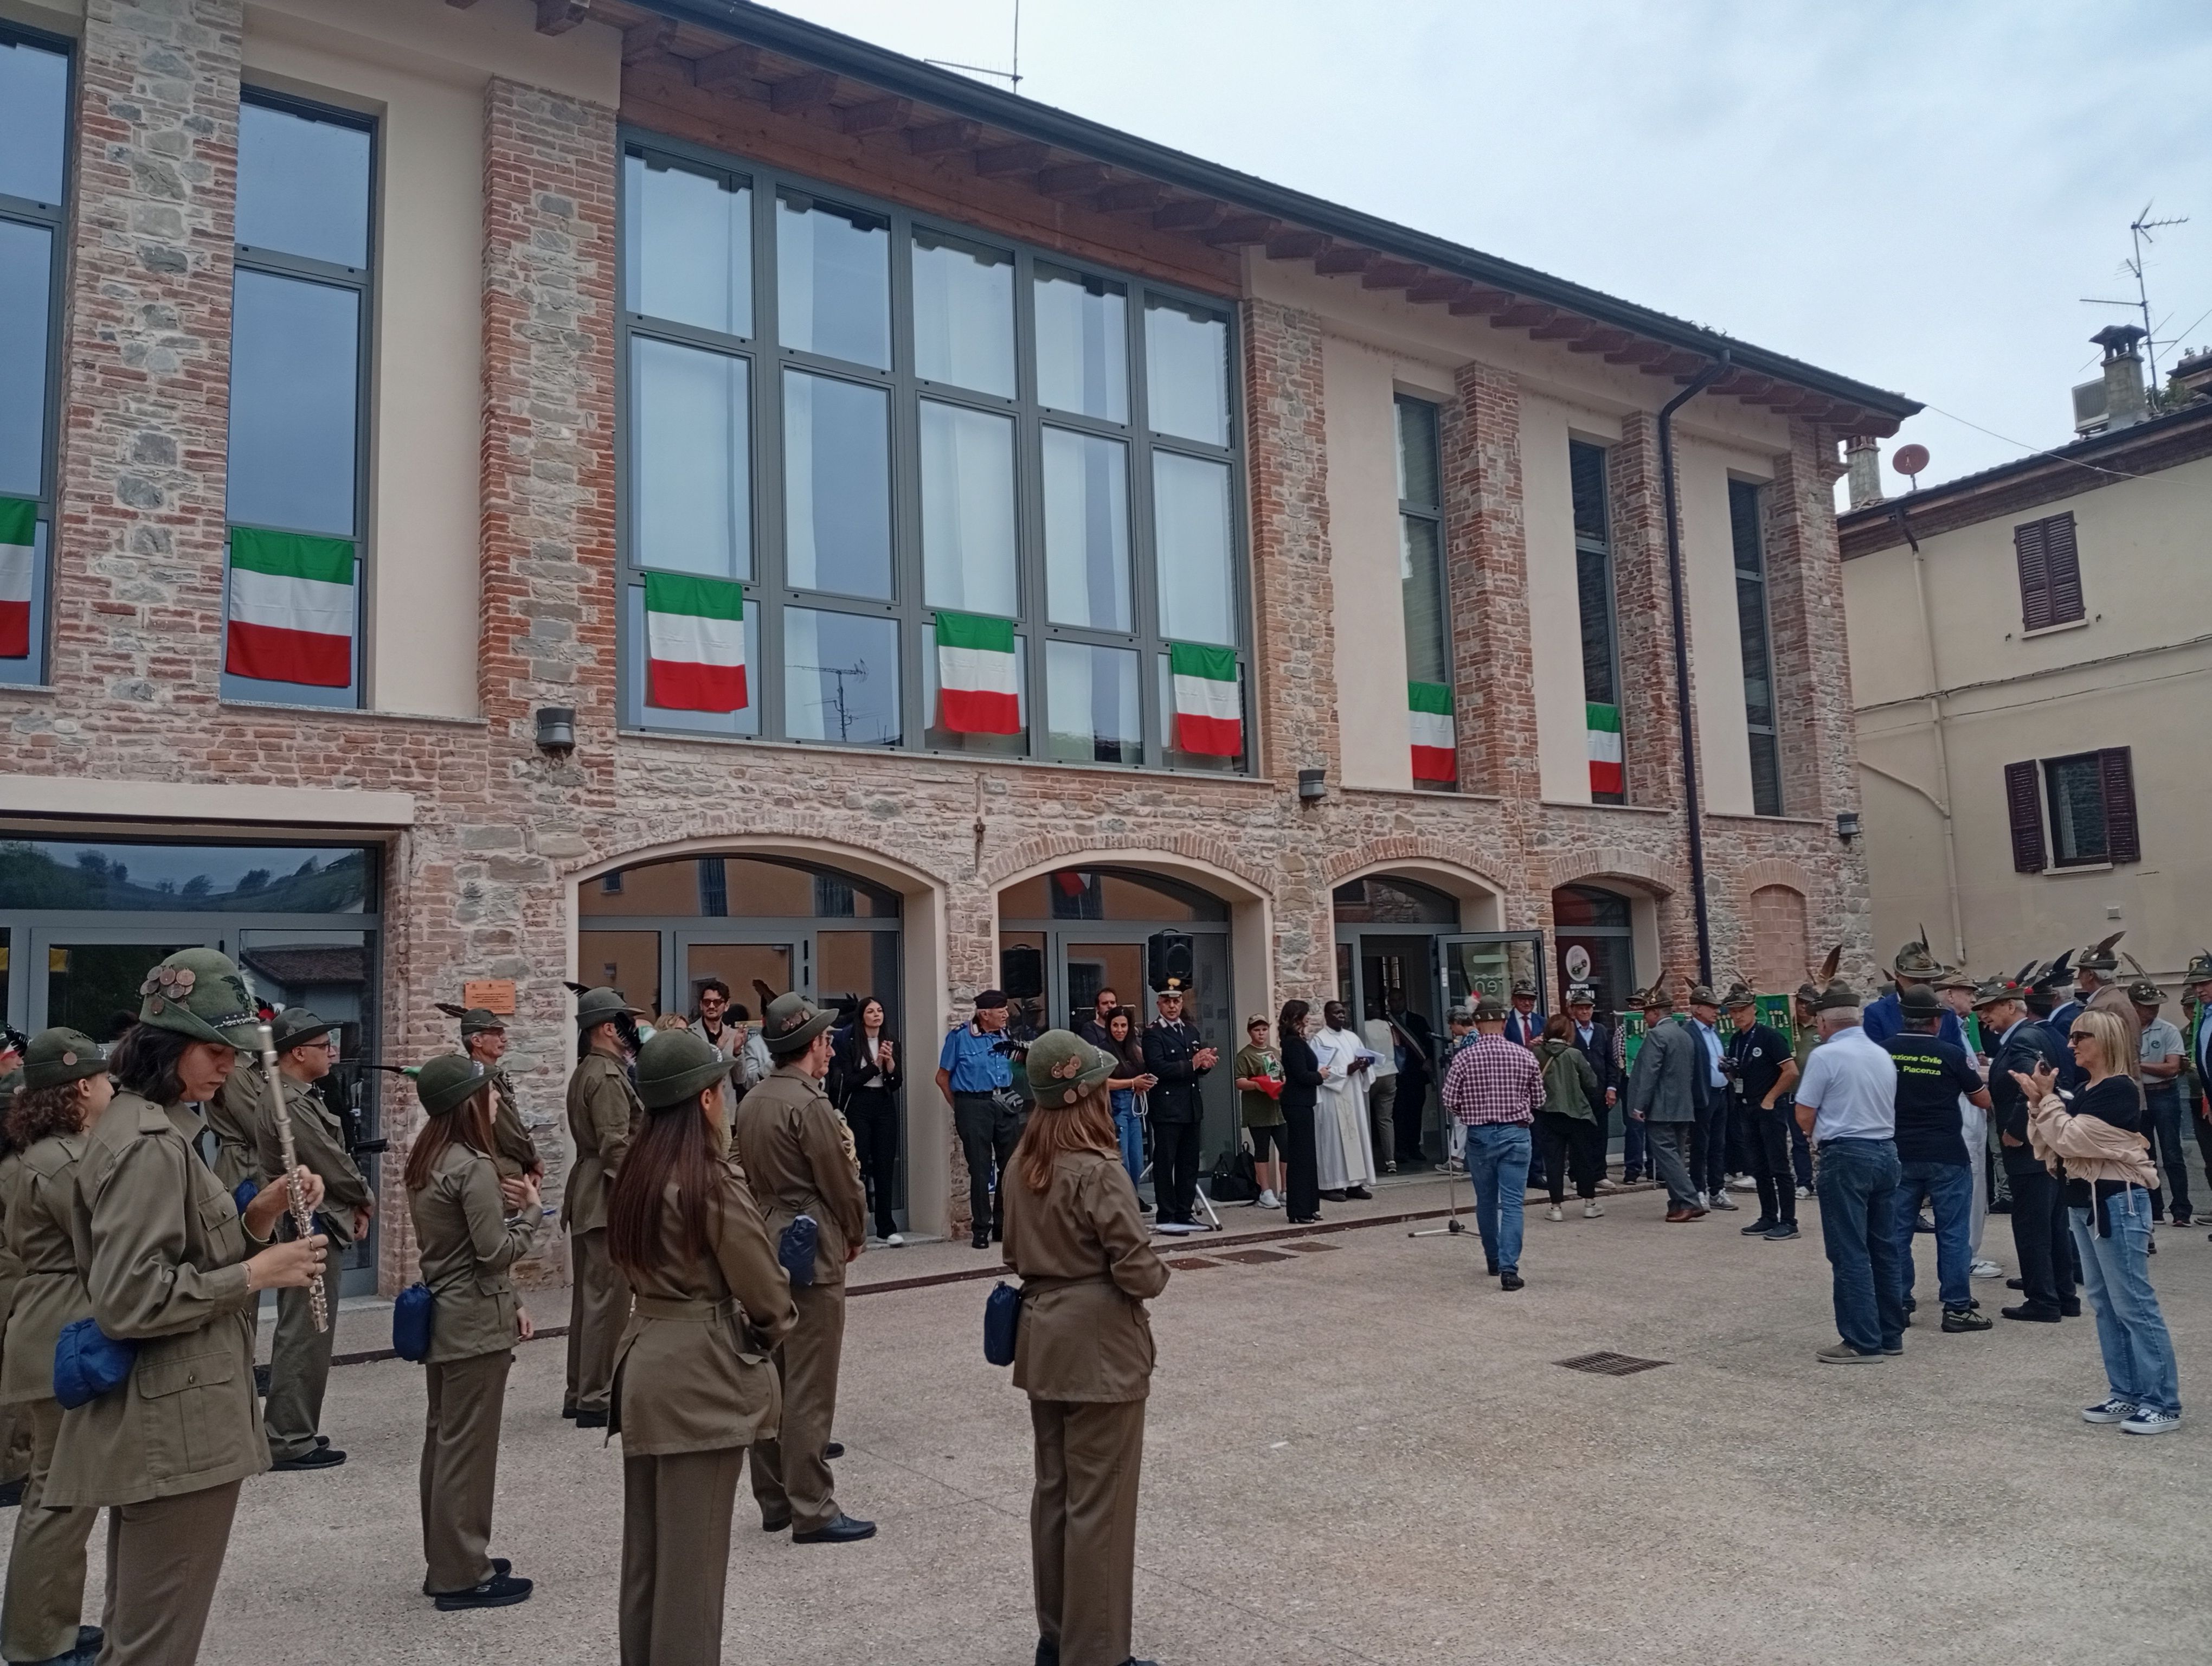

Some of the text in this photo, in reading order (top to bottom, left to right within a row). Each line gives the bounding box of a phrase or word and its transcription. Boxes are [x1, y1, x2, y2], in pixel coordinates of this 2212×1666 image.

[1566, 990, 1595, 999] ANI
[1920, 1055, 1942, 1065] Civile
[1903, 1066, 1941, 1075] Piacenza
